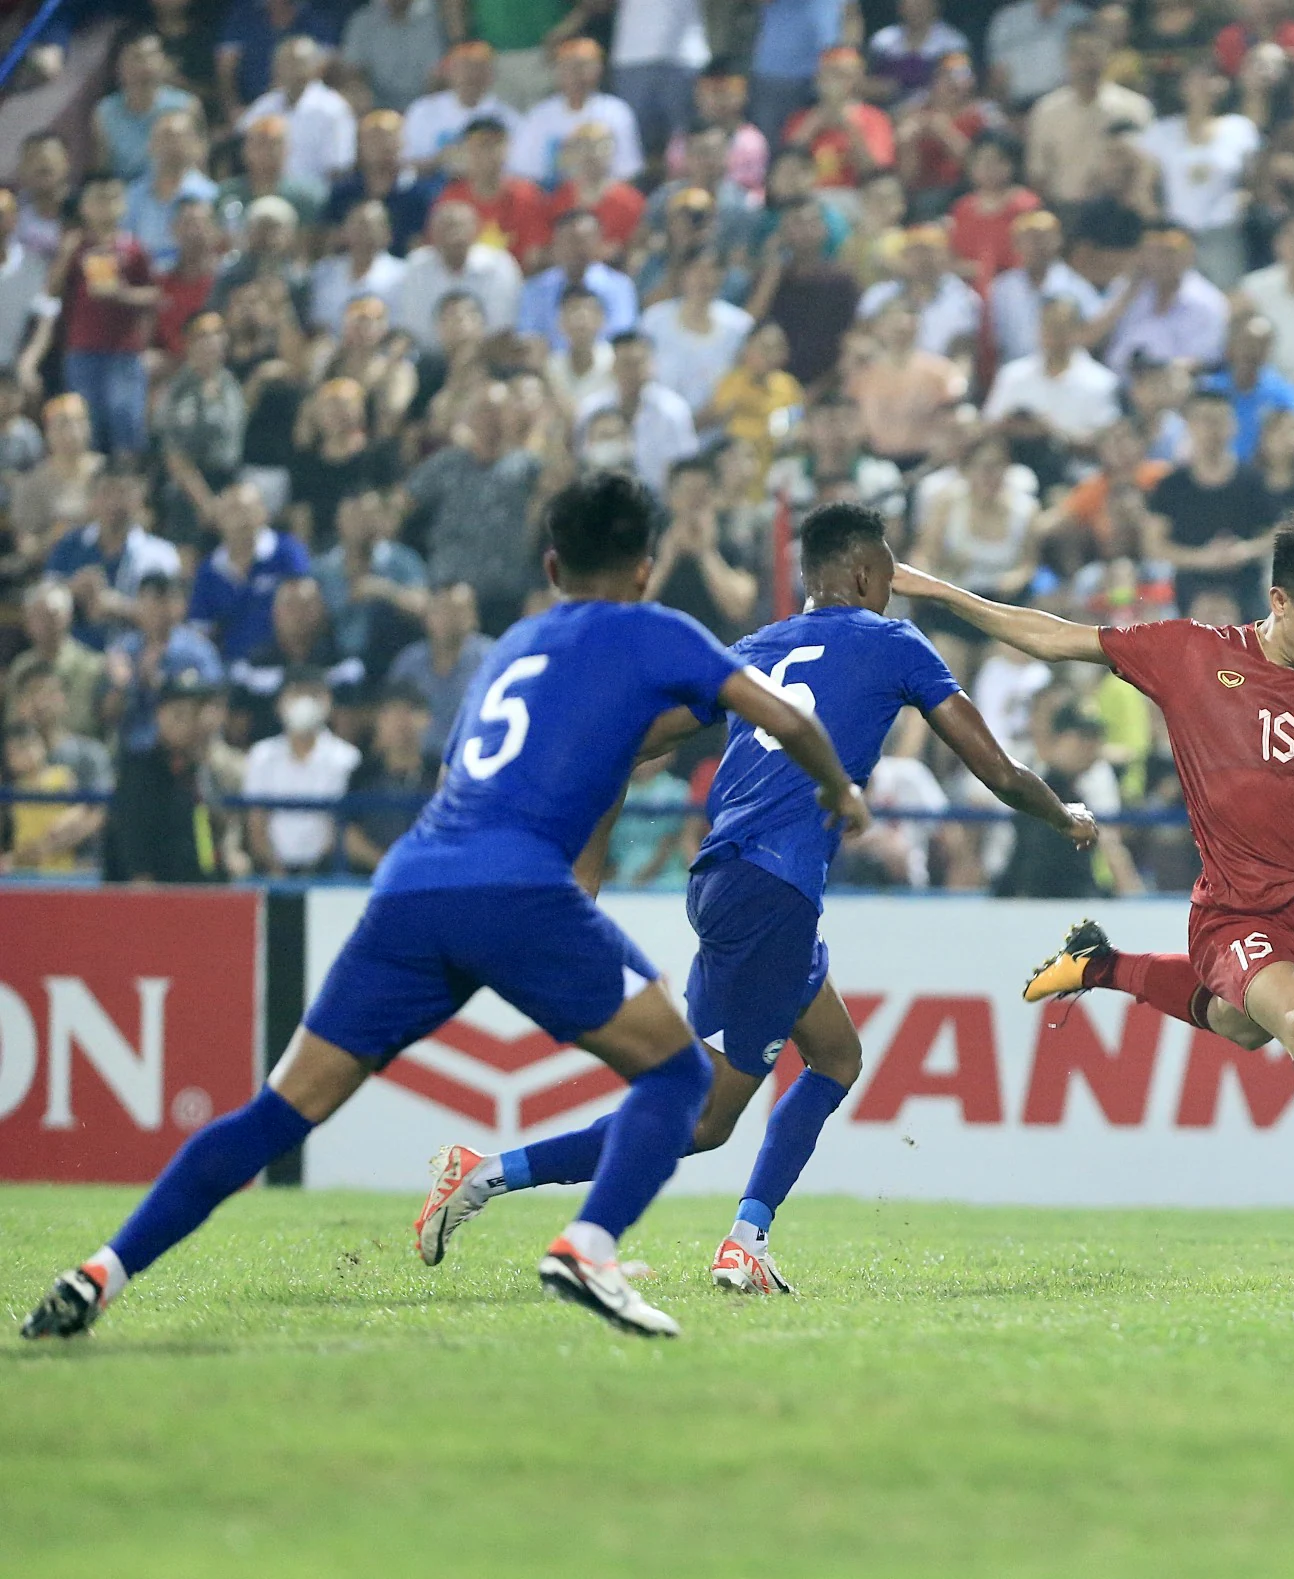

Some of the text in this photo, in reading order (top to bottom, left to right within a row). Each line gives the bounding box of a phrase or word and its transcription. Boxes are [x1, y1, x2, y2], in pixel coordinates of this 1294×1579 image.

[463, 653, 549, 781] 5
[1229, 931, 1273, 971] 15
[0, 975, 172, 1131] N
